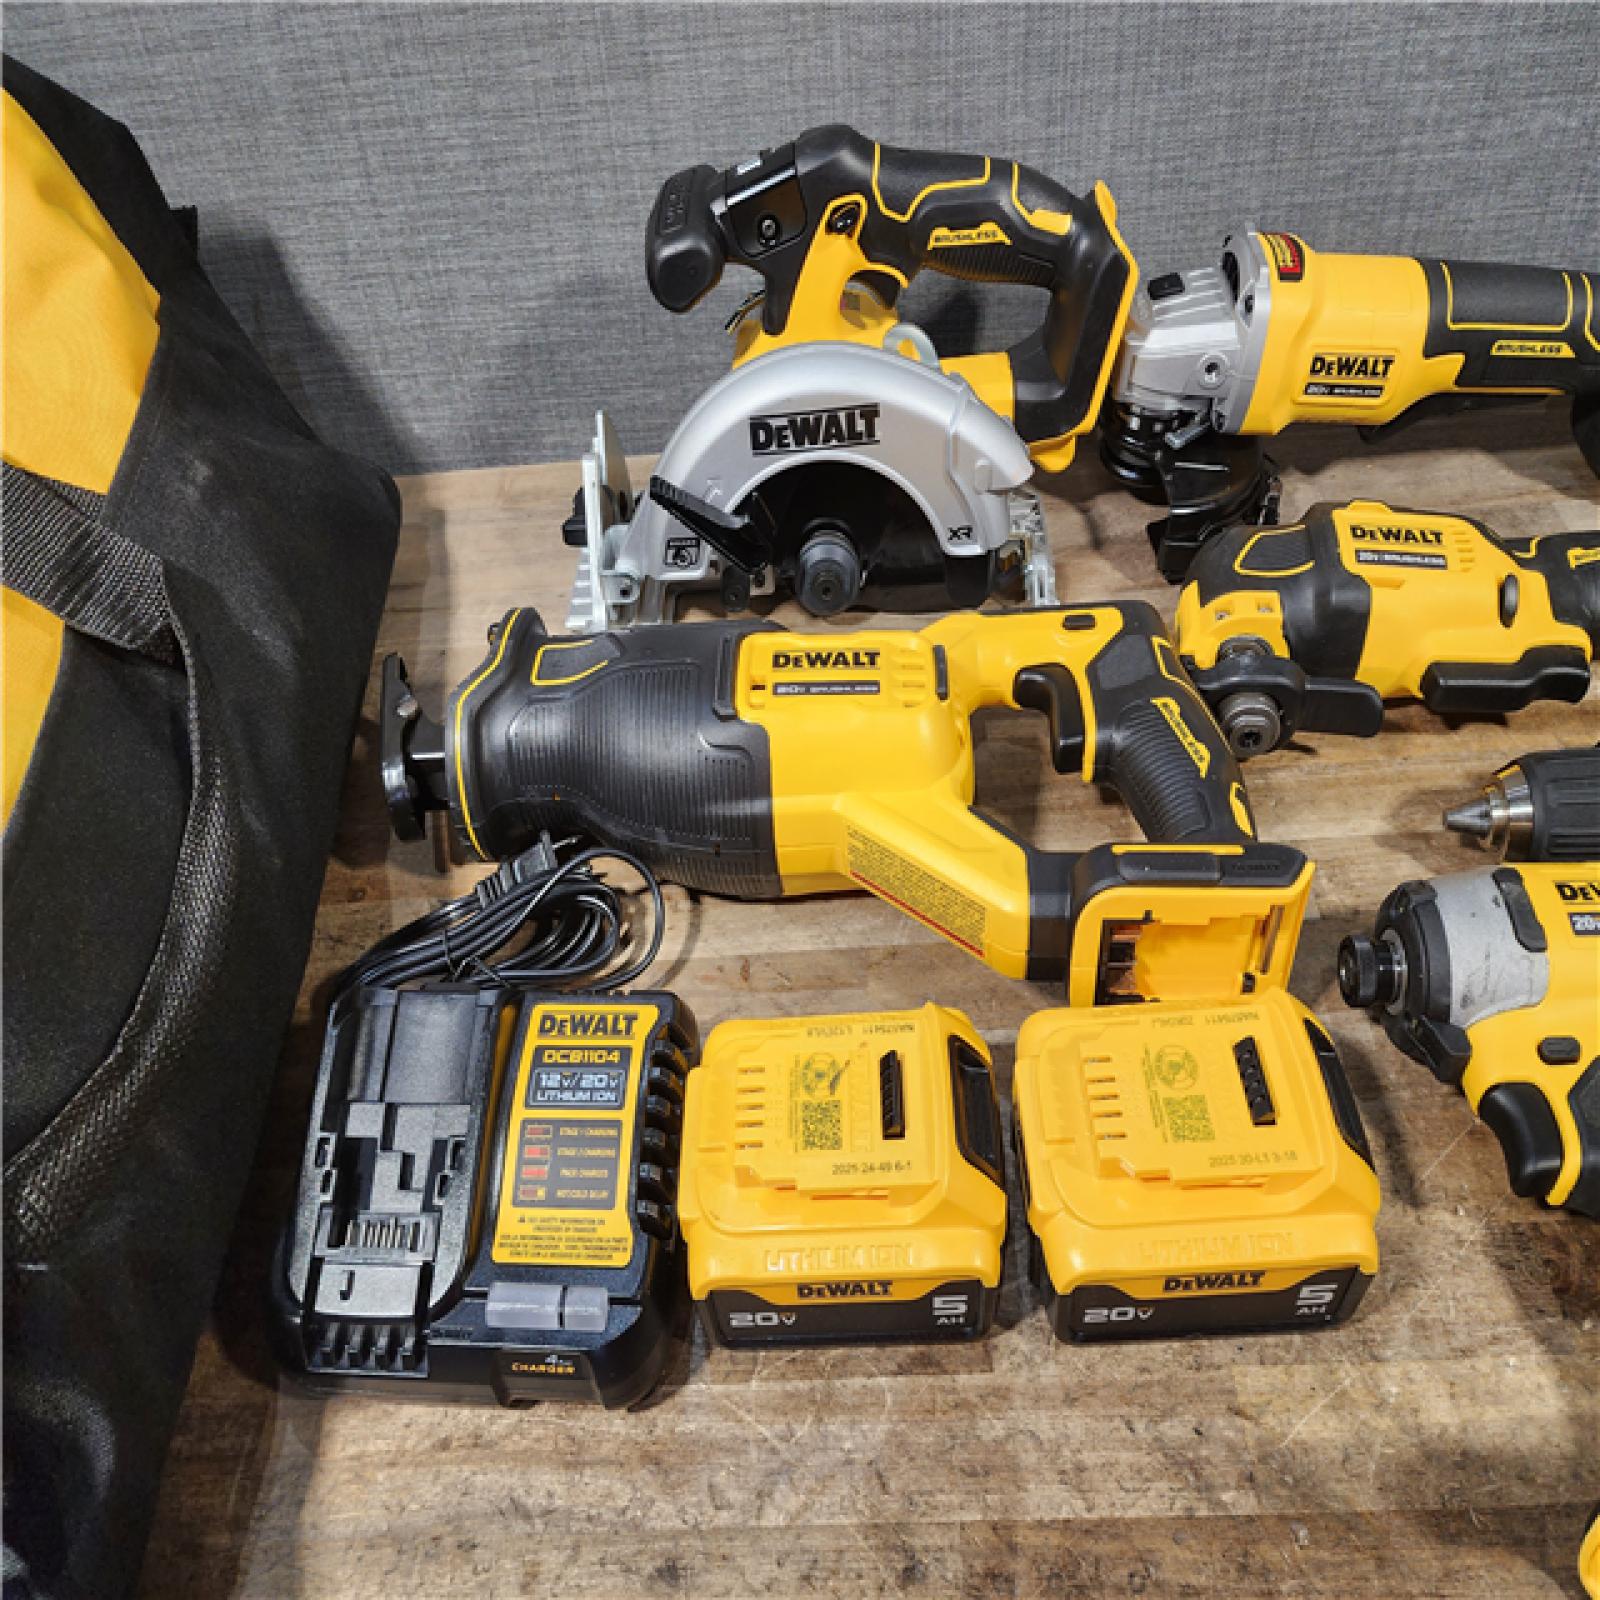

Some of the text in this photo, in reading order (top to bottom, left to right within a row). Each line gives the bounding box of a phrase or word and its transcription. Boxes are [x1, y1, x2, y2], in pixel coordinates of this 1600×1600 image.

[1309, 356, 1394, 377] DEWALT
[749, 405, 880, 452] DEWALT
[947, 525, 973, 541] XR
[1350, 526, 1444, 545] DEWALT
[772, 650, 881, 669] DEWALT
[539, 1013, 638, 1036] DEWALT
[536, 1089, 591, 1102] LITHIUM
[796, 1280, 893, 1298] DEWALT
[1162, 1270, 1266, 1292] DEWALT
[932, 1294, 968, 1316] 5
[1296, 1284, 1338, 1306] 5
[511, 1362, 576, 1376] CHARGER
